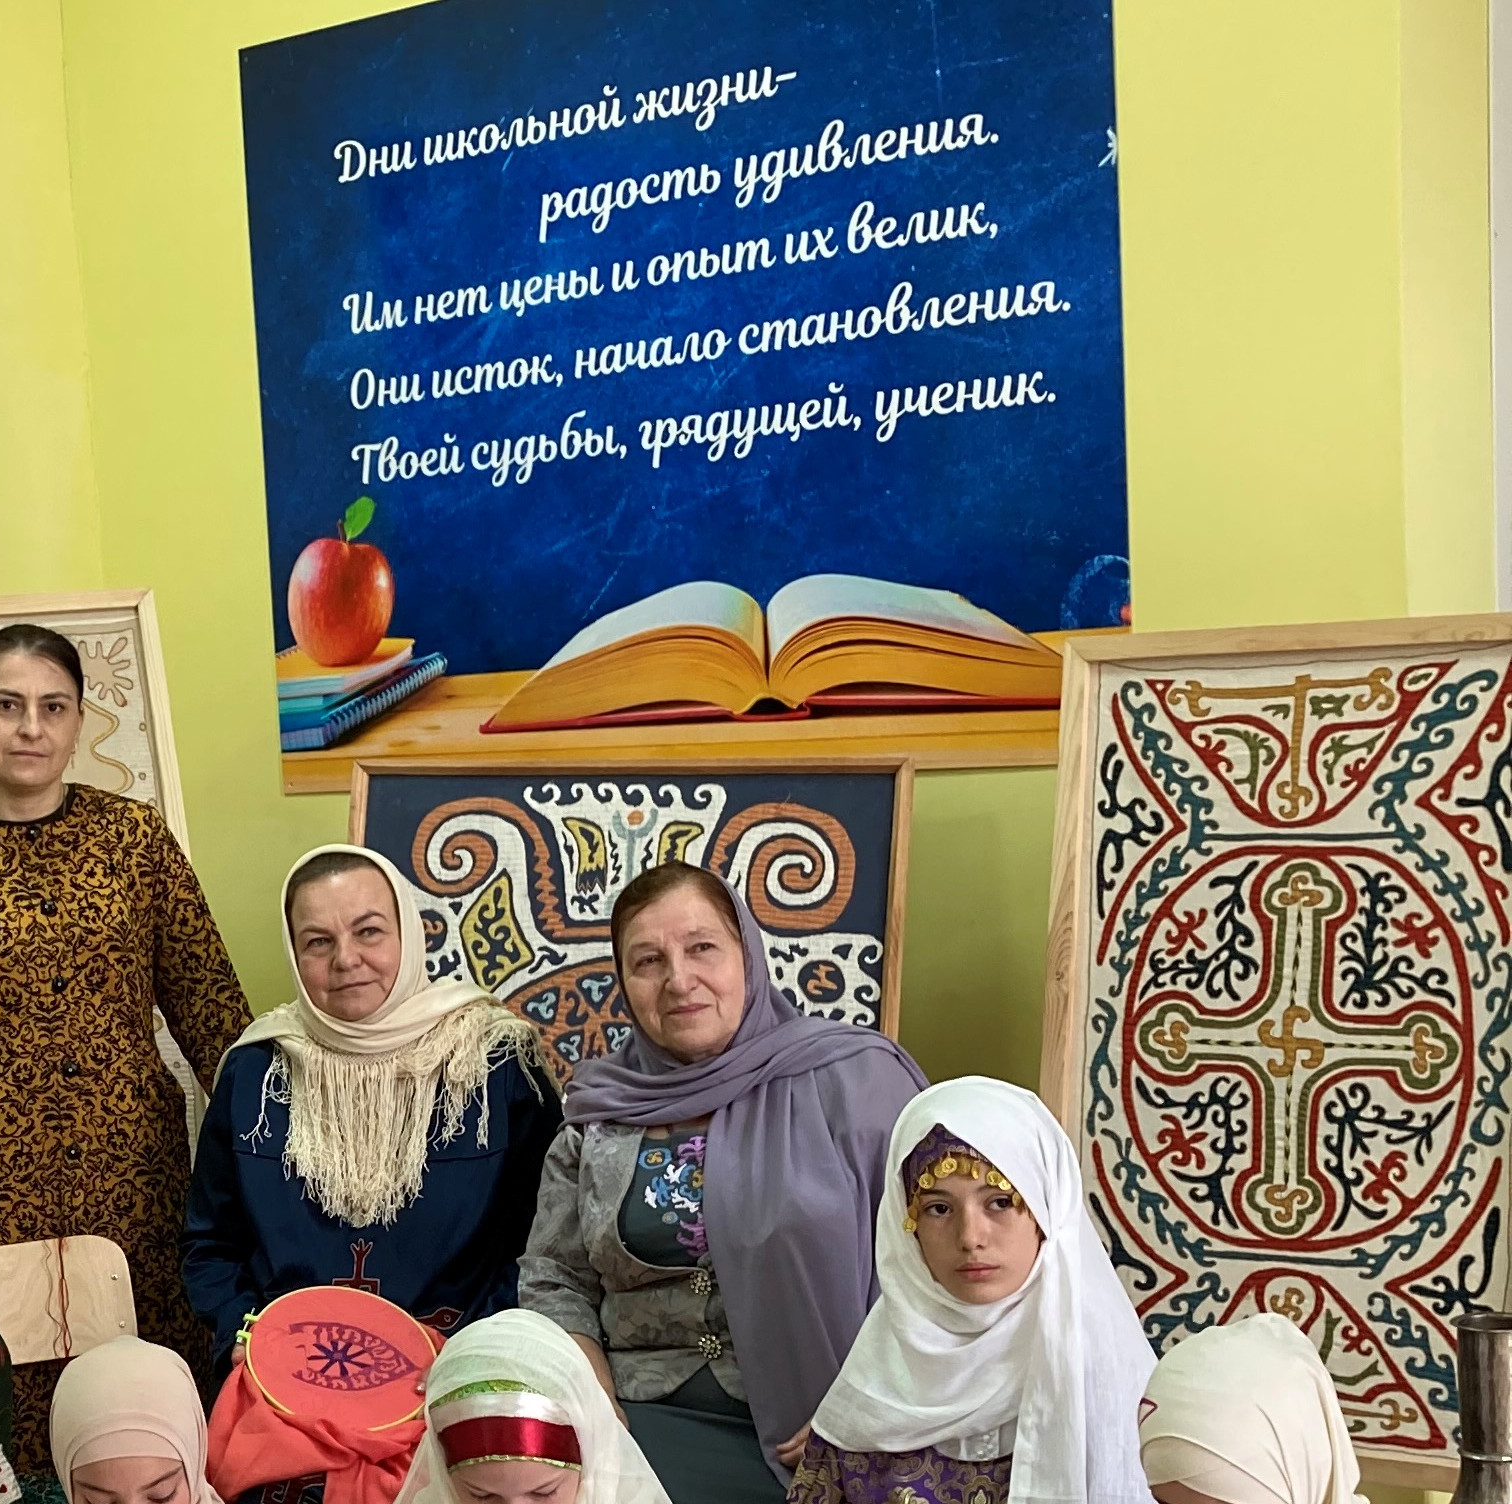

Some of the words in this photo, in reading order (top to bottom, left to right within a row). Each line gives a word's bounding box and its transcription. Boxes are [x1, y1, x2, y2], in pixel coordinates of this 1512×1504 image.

[334, 139, 417, 183] Дни
[423, 85, 626, 166] школьной
[633, 66, 797, 131] жизни-
[539, 163, 721, 243] радость
[734, 113, 999, 208] удивления.
[342, 291, 408, 334] Им
[414, 284, 492, 324] нет
[500, 266, 604, 317] цены
[612, 260, 639, 292] и
[647, 237, 776, 286] опыт
[784, 227, 839, 264] их
[847, 201, 998, 254] велик,
[350, 368, 425, 410] Они
[432, 354, 564, 399] исток,
[574, 327, 731, 379] начало
[738, 280, 1071, 354] становления.
[351, 433, 464, 484] Твоей
[471, 410, 627, 487] судьбы,
[639, 382, 862, 468] грядущей,
[875, 371, 1056, 442] ученик.
